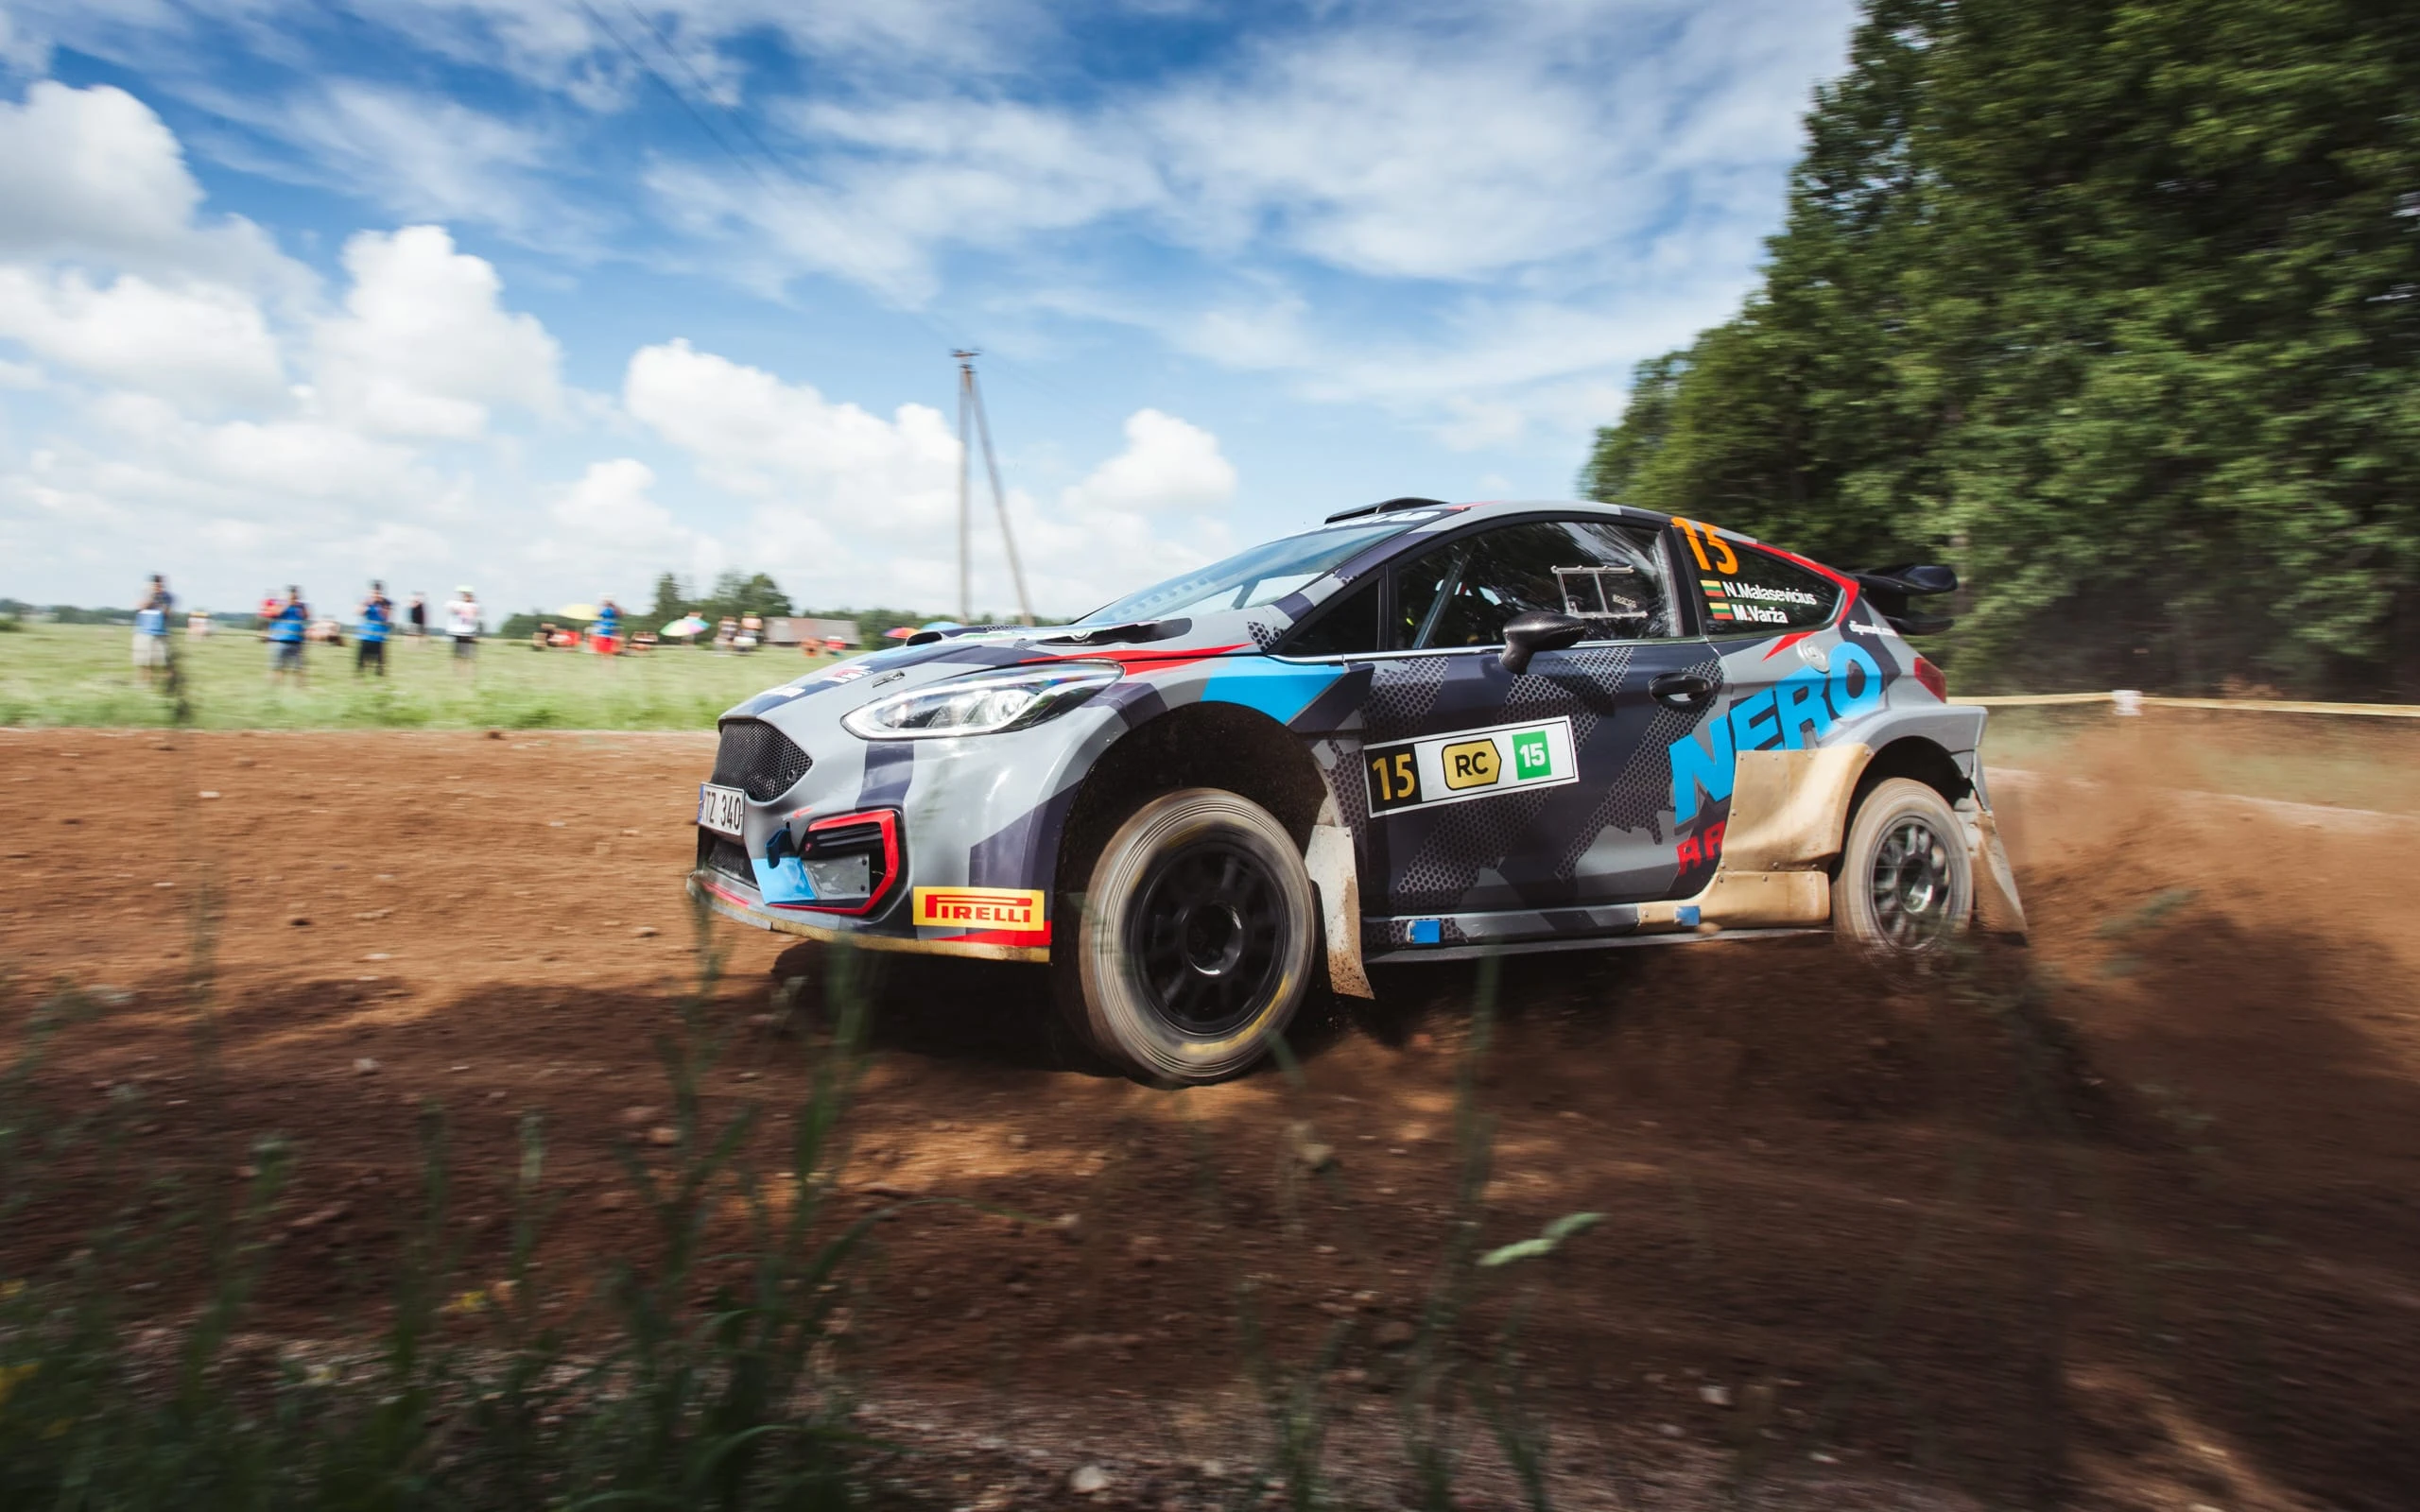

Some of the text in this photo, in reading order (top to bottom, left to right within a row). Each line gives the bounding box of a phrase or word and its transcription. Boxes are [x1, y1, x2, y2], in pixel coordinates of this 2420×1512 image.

[1671, 517, 1738, 575] 15
[1668, 642, 1882, 825] NERO
[1372, 743, 1546, 800] 15 RC 15
[720, 793, 741, 830] 340
[925, 894, 1032, 922] PIRELLI
